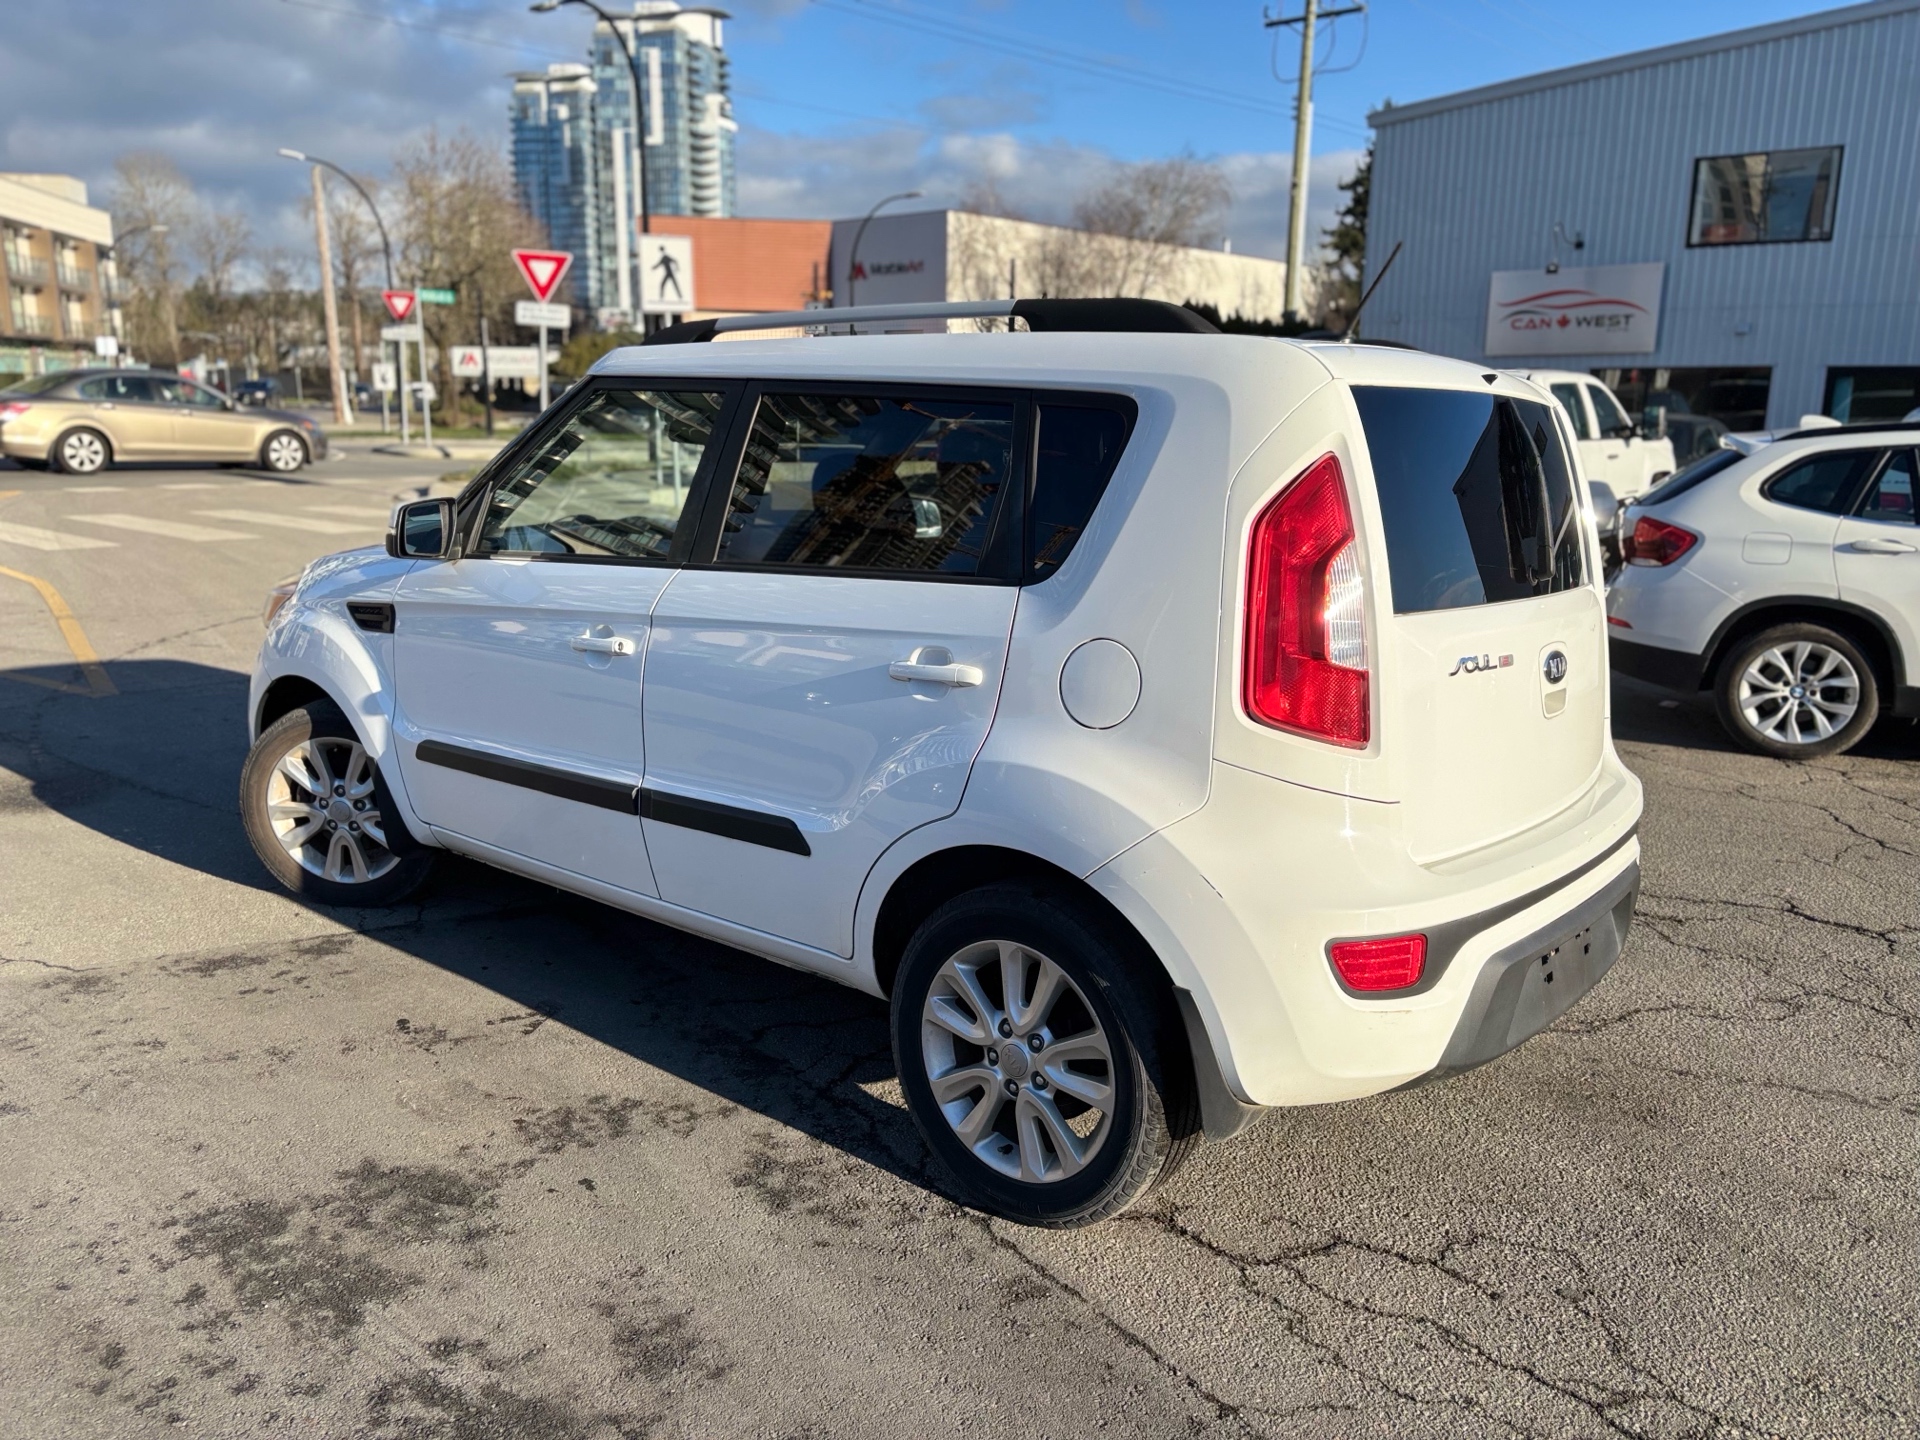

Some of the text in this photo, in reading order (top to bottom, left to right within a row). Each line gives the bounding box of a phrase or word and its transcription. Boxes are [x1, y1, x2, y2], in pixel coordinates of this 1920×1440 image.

[1510, 313, 1634, 330] CAN WEST
[1549, 655, 1567, 680] KIA
